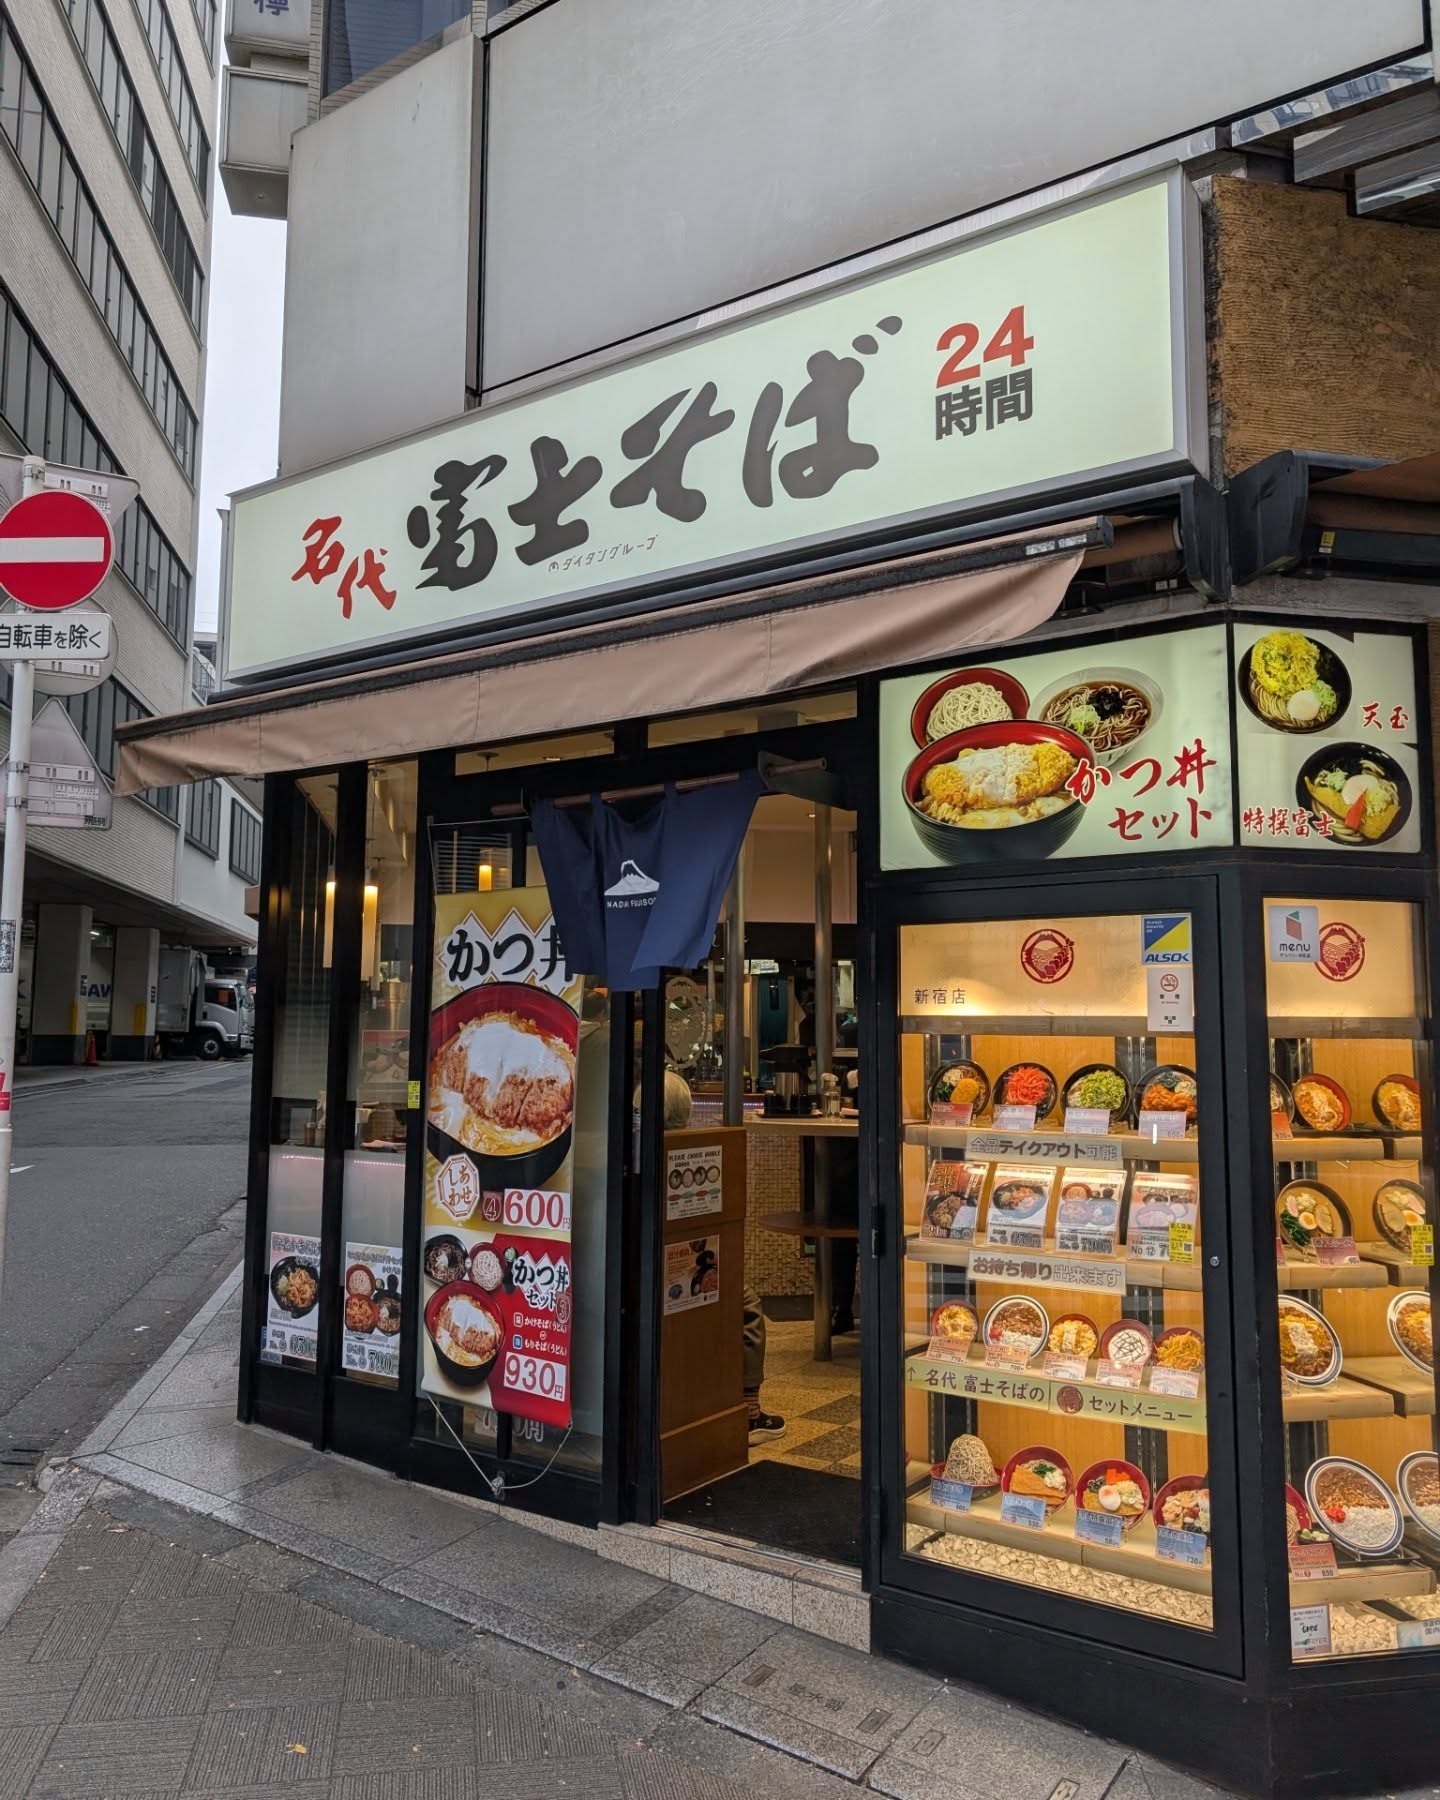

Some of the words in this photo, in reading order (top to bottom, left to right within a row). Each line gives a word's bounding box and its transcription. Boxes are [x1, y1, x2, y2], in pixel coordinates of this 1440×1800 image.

[936, 305, 1034, 388] 24
[935, 368, 1033, 440] 時間
[292, 516, 397, 619] 名代
[563, 534, 659, 571] ダイタングループ
[0, 623, 102, 650] 自転車を除く
[1360, 702, 1410, 731] 天玉
[1066, 738, 1217, 806] かつ丼
[1107, 796, 1214, 842] セット
[1243, 806, 1336, 839] 特撰富士
[447, 929, 575, 982] かつ丼
[1145, 952, 1190, 963] ALSOK
[1279, 943, 1311, 952] menu
[913, 987, 967, 1007] 新宿店
[970, 1136, 1119, 1161] 全品テイクアウト可能
[505, 1190, 571, 1230] 600円
[514, 1258, 569, 1292] かつ丼
[973, 1256, 1121, 1288] お持ち帰り出来ます
[526, 1288, 557, 1310] セット
[506, 1354, 564, 1400] 930円
[924, 1368, 957, 1390] 名代
[964, 1374, 1045, 1402] 富士そばの
[1089, 1395, 1193, 1420] セットメニュー
